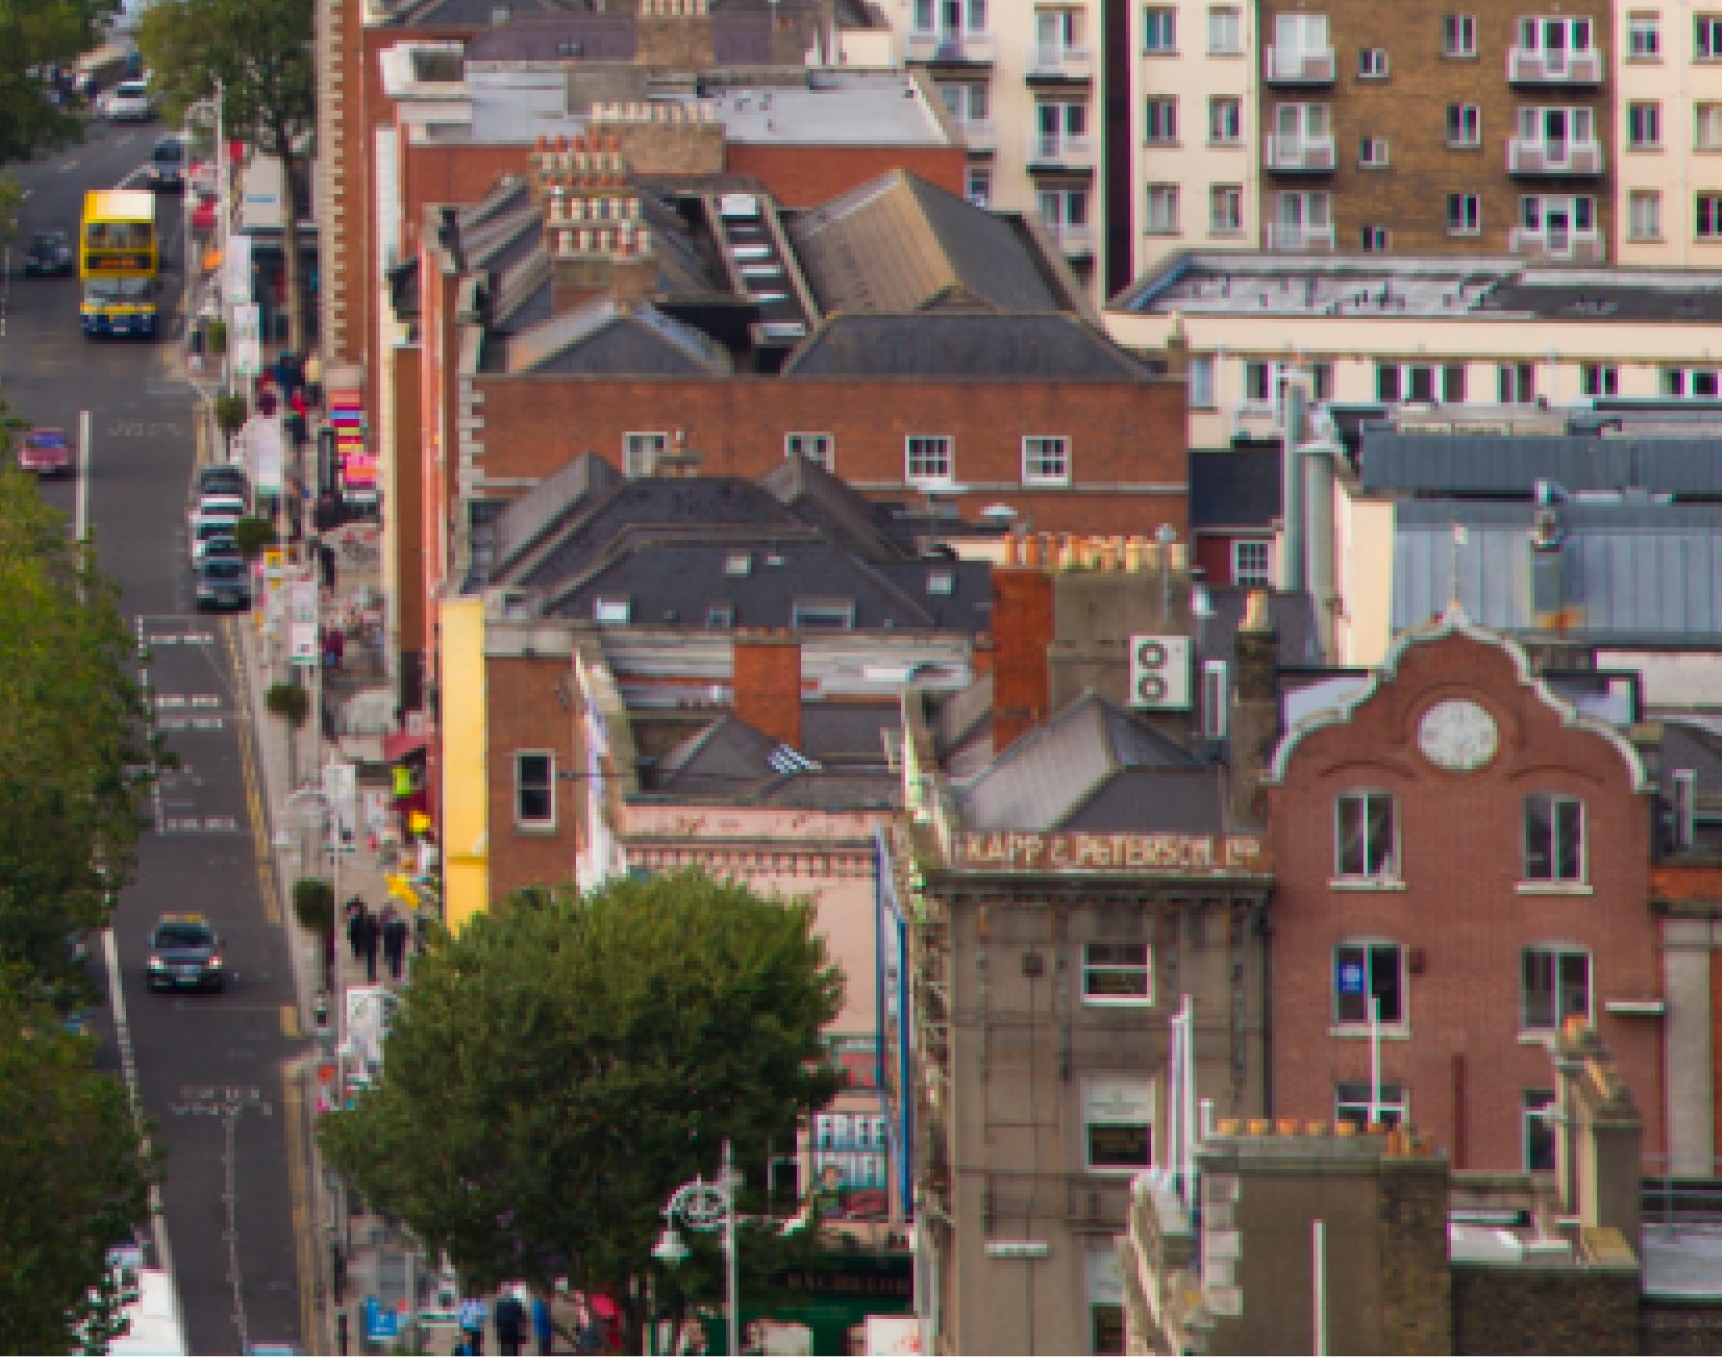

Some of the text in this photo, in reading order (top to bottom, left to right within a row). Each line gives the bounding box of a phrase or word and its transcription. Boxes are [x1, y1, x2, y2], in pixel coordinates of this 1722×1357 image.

[965, 831, 1043, 863] KAPP
[1075, 832, 1210, 866] PETERSON
[814, 1114, 886, 1149] FREE
